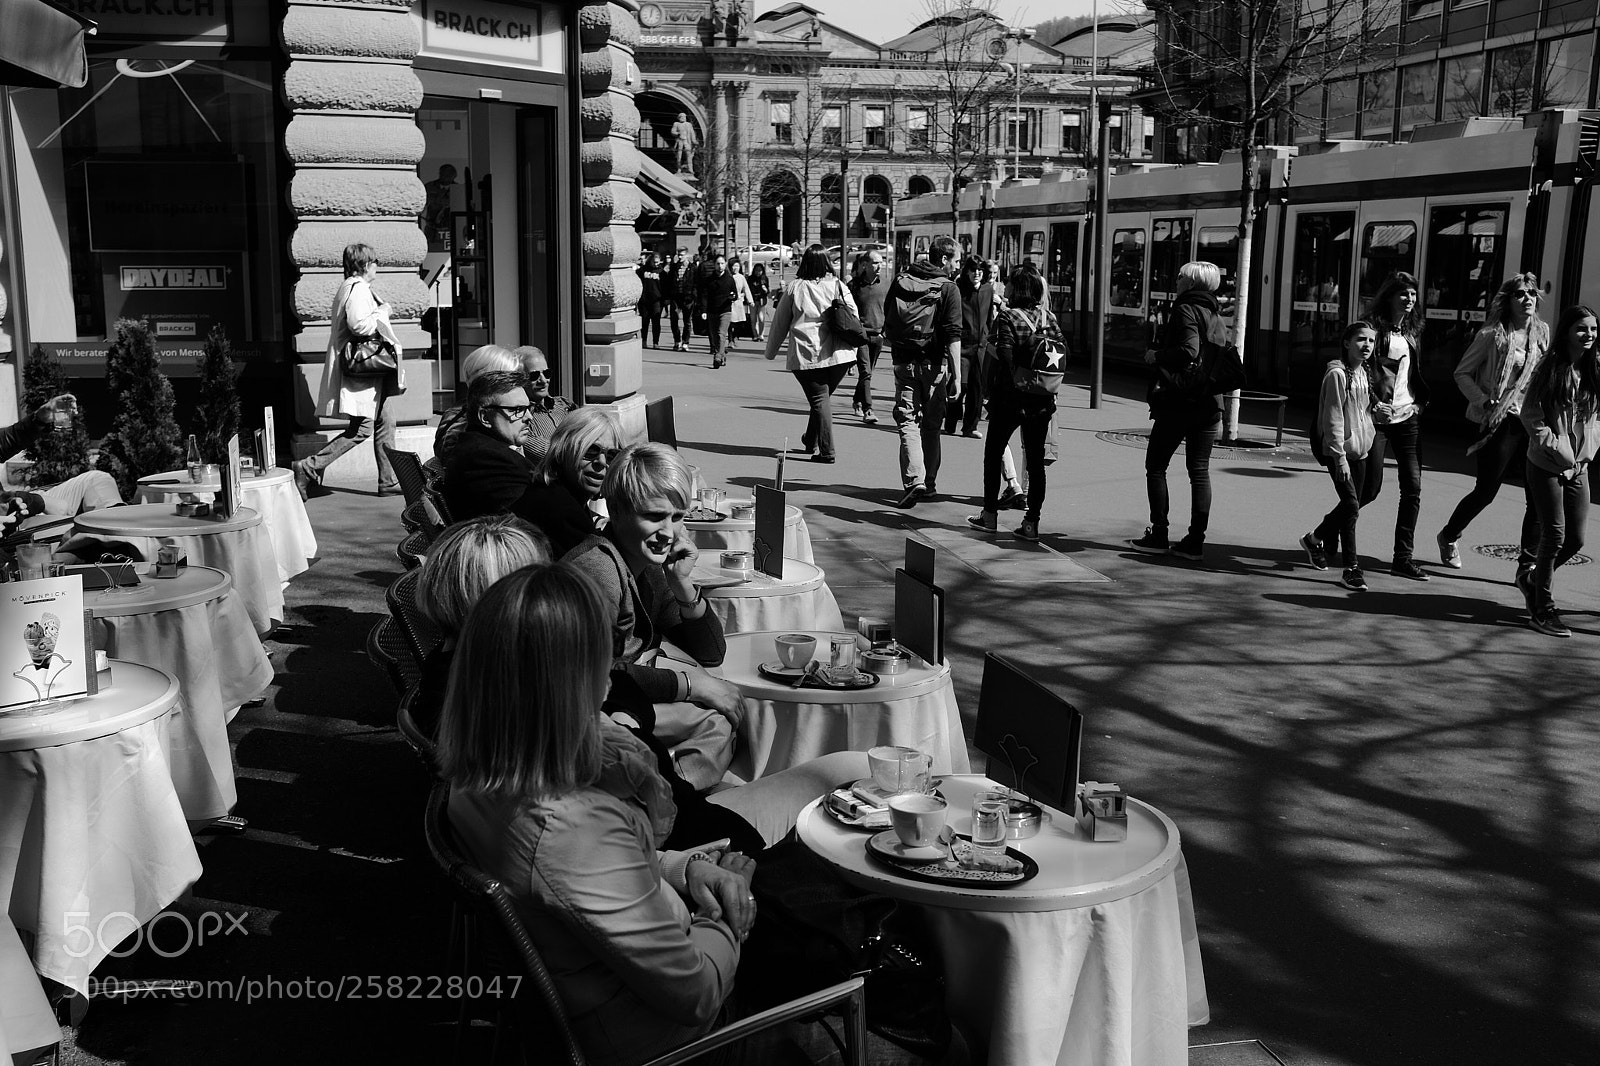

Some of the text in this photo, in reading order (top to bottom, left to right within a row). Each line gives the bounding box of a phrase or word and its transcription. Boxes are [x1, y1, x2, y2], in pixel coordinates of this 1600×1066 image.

[434, 10, 532, 39] BRACK.CH
[639, 35, 658, 44] SBB
[678, 36, 697, 45] FFS
[122, 268, 223, 287] DAYDEAL
[56, 348, 72, 357] Wir
[11, 591, 67, 602] MÖVENPICK
